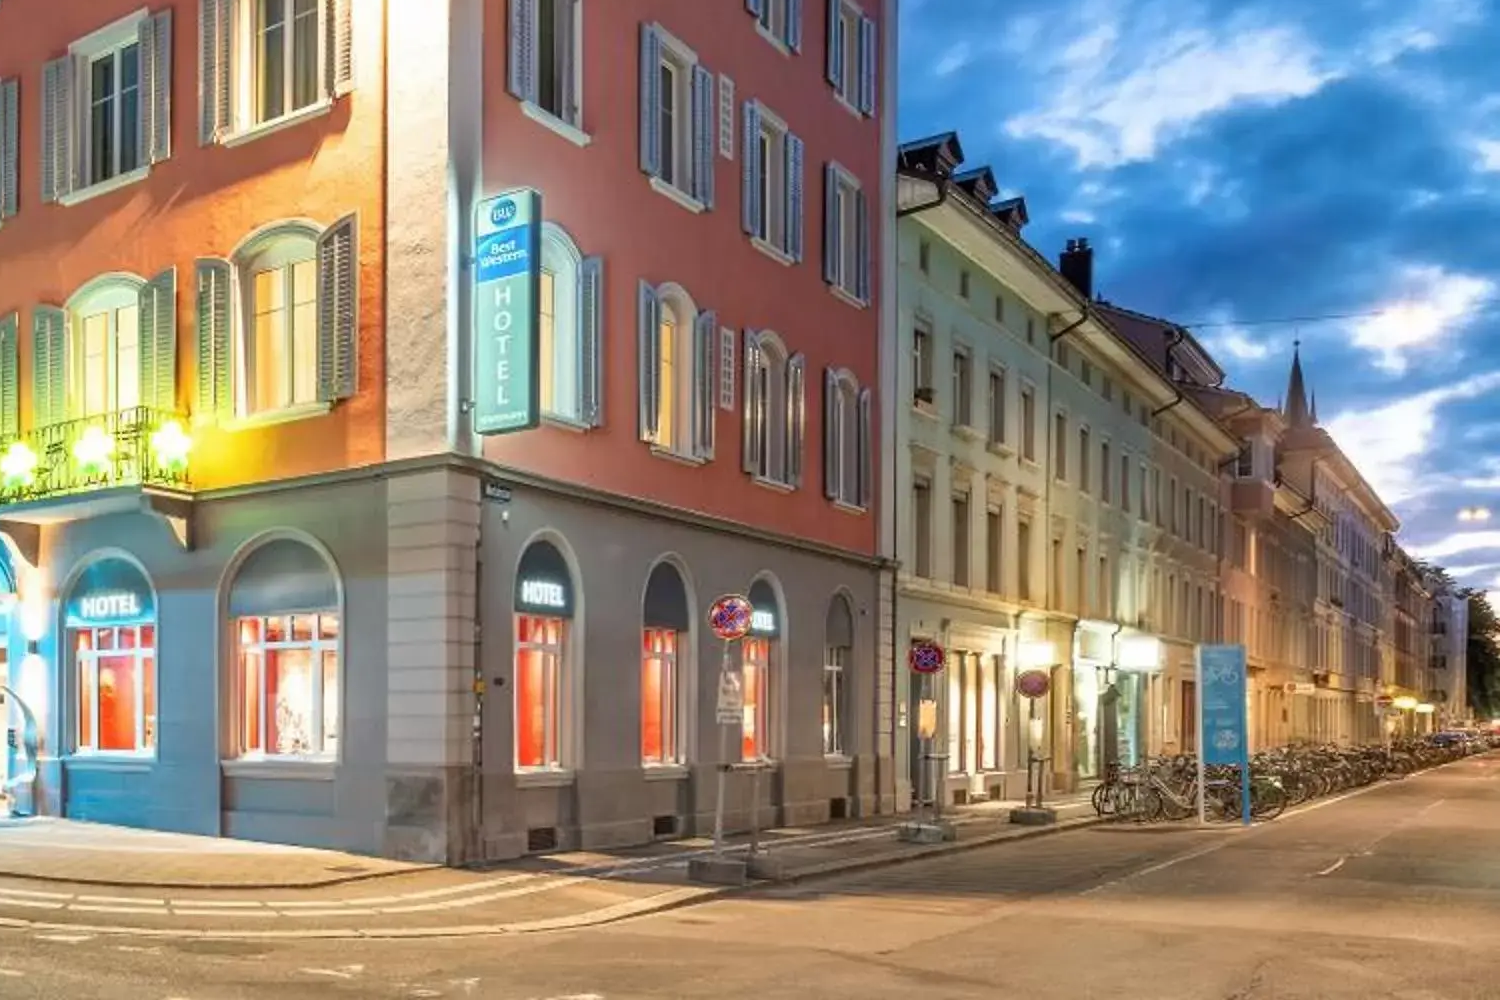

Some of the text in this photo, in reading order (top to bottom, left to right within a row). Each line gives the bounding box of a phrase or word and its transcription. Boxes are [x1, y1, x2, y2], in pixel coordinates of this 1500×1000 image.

[491, 240, 516, 254] Best
[494, 286, 512, 405] HOTEL
[81, 592, 141, 618] HOTEL
[522, 580, 565, 607] HOTEL
